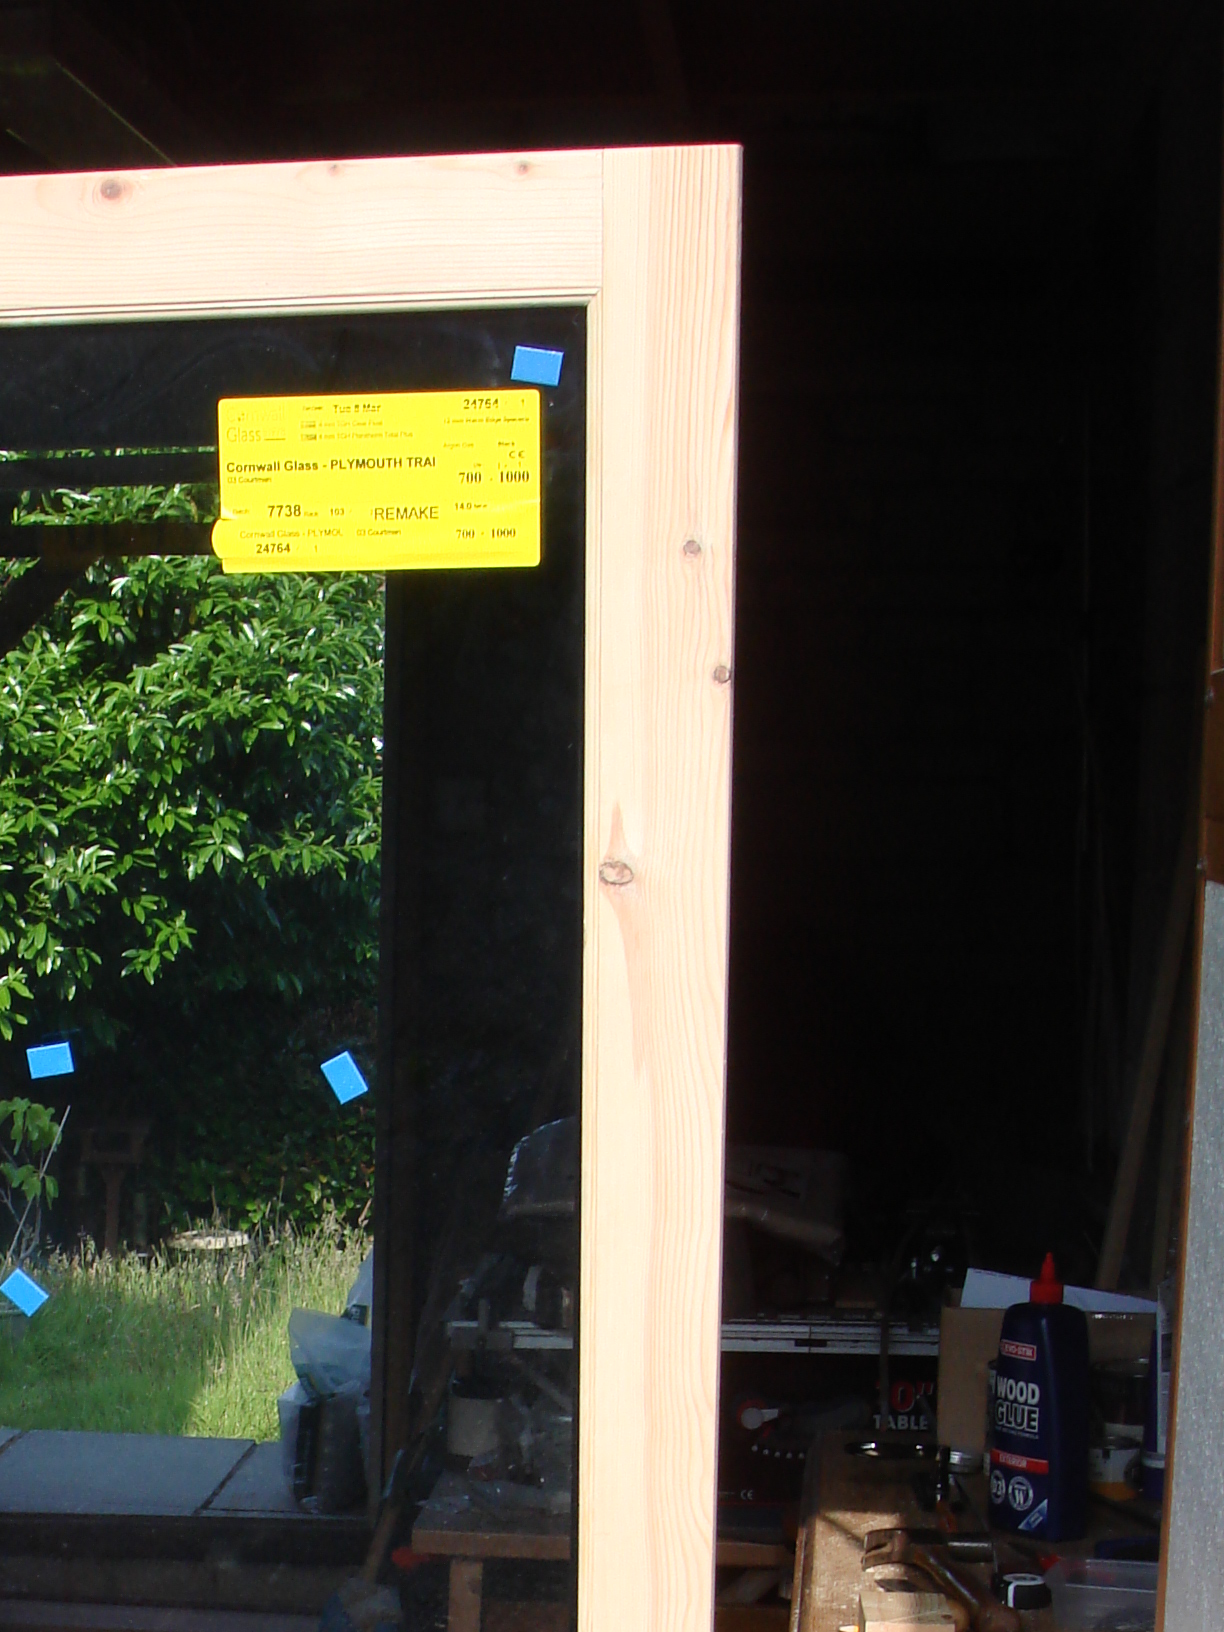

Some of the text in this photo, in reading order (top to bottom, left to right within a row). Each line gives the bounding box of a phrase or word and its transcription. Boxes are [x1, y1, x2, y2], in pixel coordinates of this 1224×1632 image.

[226, 427, 262, 443] Glass
[226, 461, 281, 473] Cornwall
[283, 460, 319, 472] Glass
[330, 457, 403, 470] PLYMOUTH
[406, 456, 436, 468] TRAI
[458, 470, 530, 484] 700 1000
[267, 504, 302, 518] 7738
[374, 506, 440, 521] REMAKE
[456, 528, 517, 539] 700 1000
[256, 543, 291, 554] 24764
[996, 1375, 1041, 1405] WOOD
[995, 1399, 1040, 1433] GLUE
